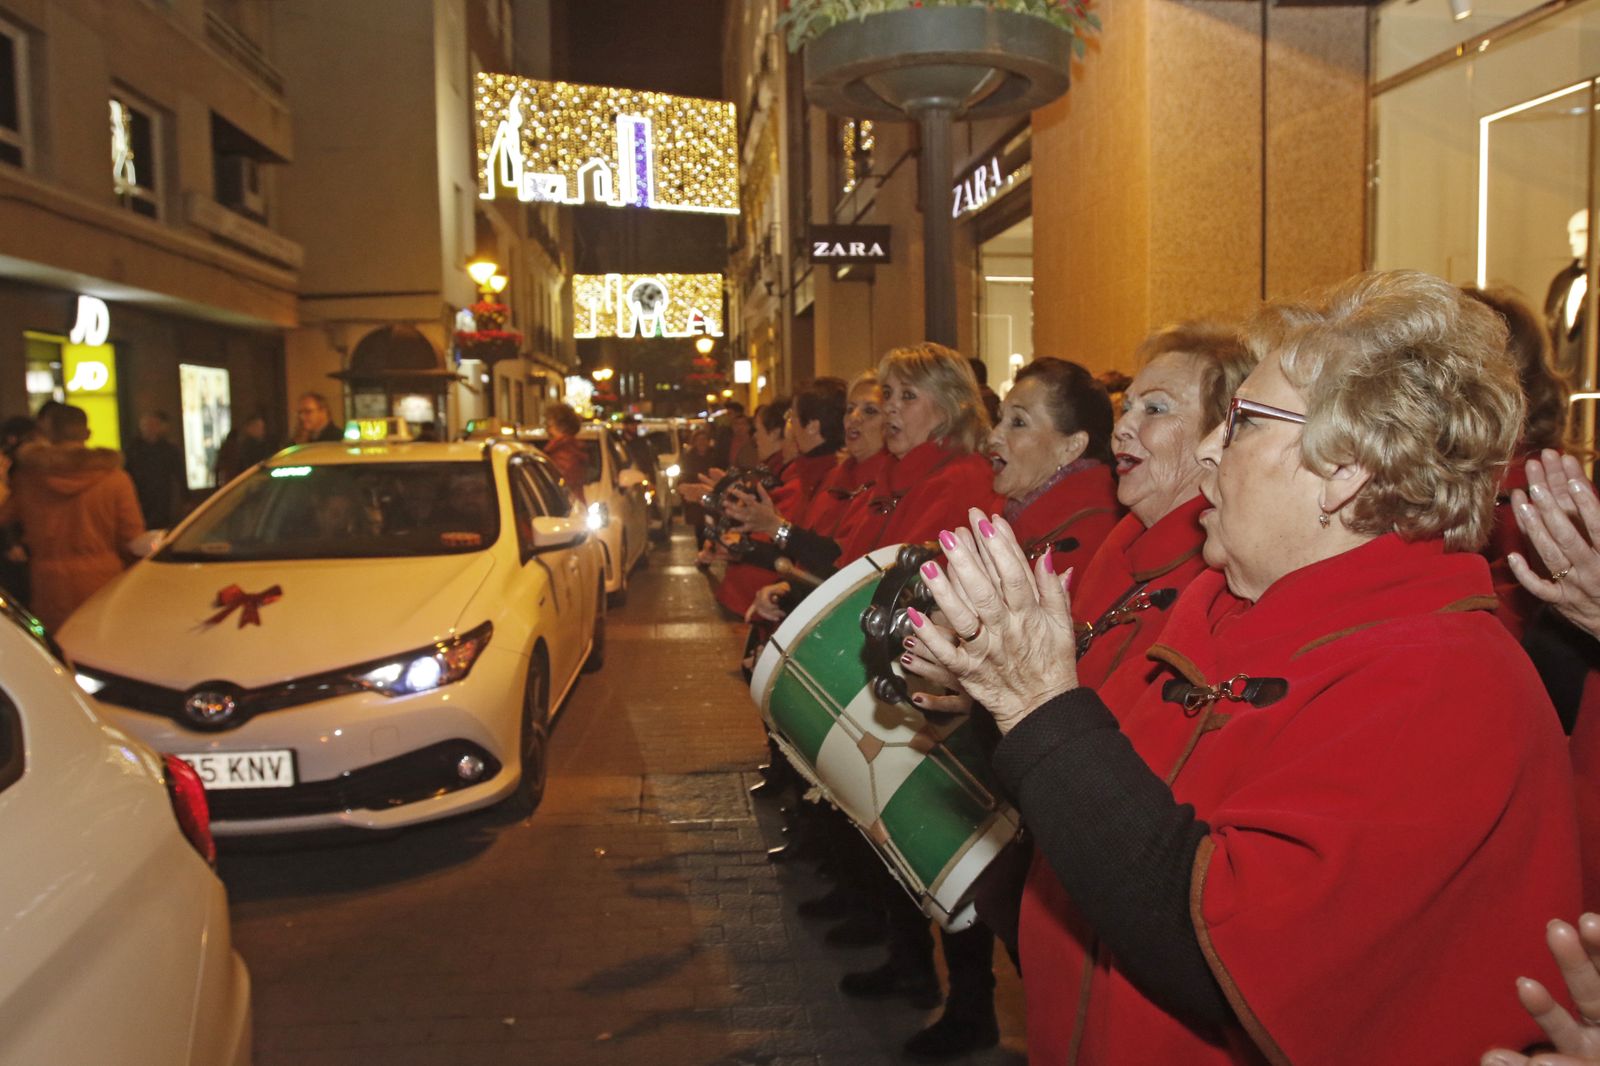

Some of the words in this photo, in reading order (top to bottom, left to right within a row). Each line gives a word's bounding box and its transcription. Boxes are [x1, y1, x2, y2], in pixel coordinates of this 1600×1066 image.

[952, 157, 1002, 218] ZARA
[813, 242, 885, 257] ZARA
[70, 295, 110, 347] JD
[67, 361, 109, 391] JD
[227, 756, 283, 782] KNV
